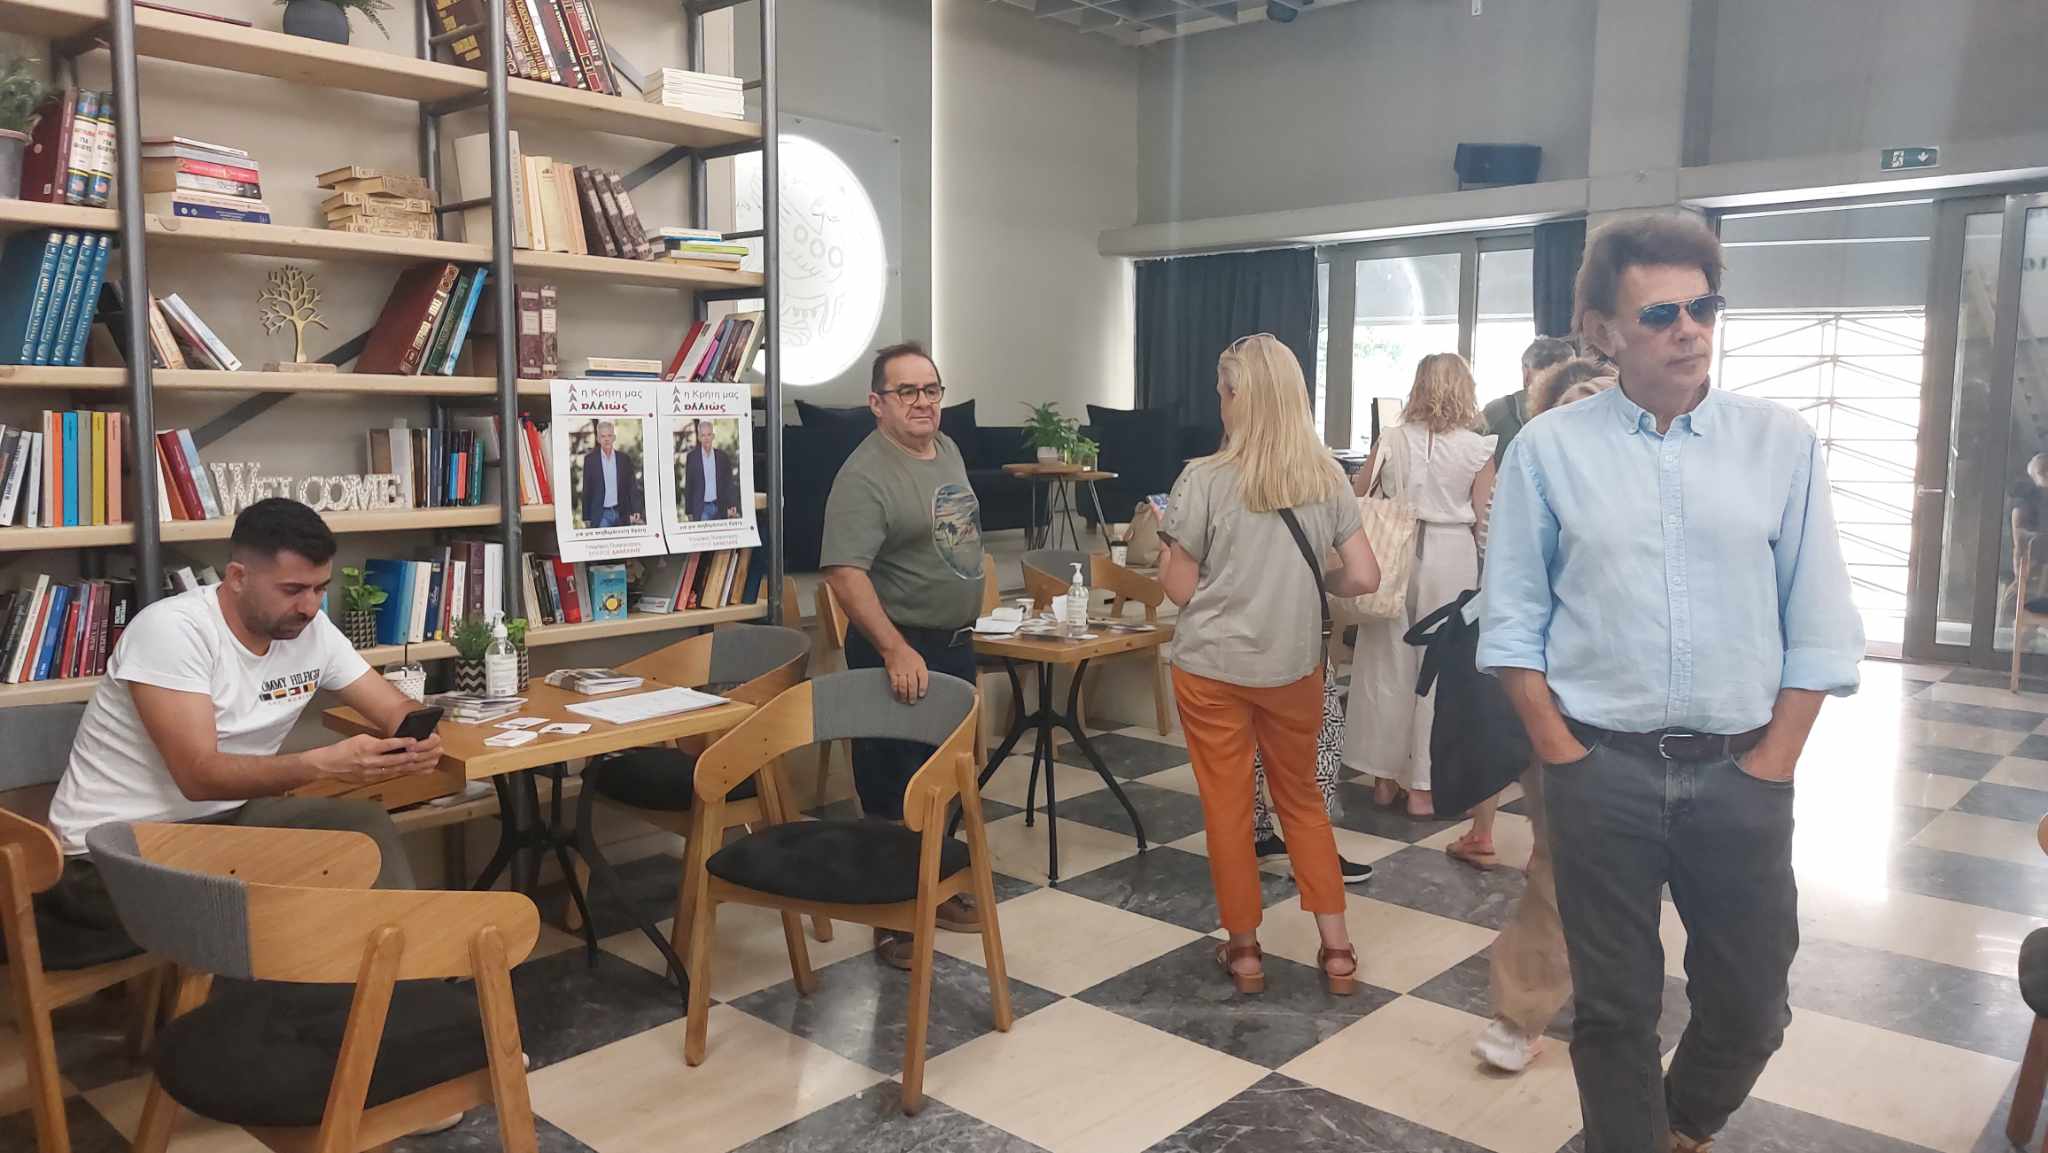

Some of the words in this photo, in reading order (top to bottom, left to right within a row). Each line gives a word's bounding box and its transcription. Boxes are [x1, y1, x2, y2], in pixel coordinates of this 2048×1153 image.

[591, 387, 622, 399] Κρήτη
[624, 389, 643, 399] μας
[692, 389, 720, 400] Κρήτη
[722, 390, 739, 400] μας
[581, 401, 628, 412] αλλιώς
[210, 461, 404, 516] WELCOME
[261, 676, 287, 692] OMMY
